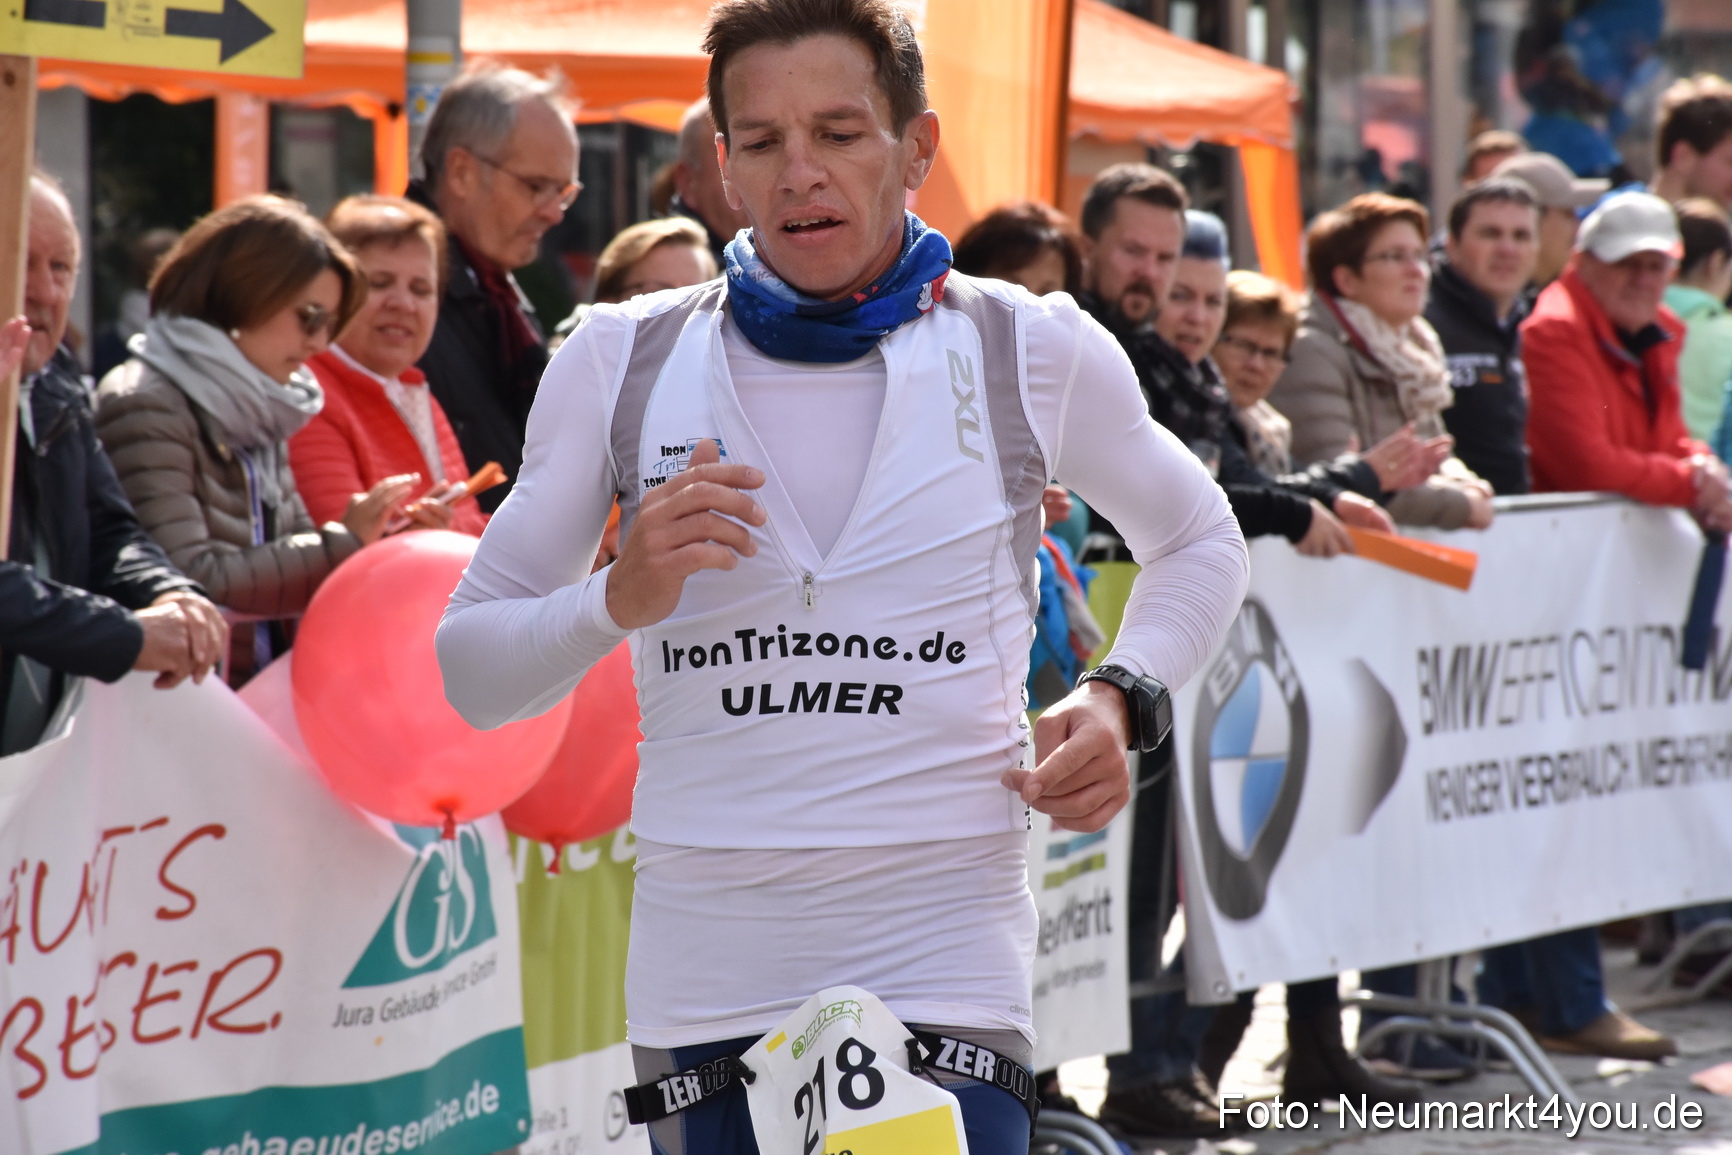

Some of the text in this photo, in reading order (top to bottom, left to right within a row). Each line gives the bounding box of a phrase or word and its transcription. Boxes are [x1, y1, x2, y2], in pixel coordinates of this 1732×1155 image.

[945, 348, 985, 464] 2XU
[662, 624, 967, 674] IronTrizone.de
[720, 681, 904, 717] ULMER
[332, 1002, 375, 1028] Jura
[657, 1057, 730, 1114] ZEROD
[794, 1037, 885, 1155] 218
[935, 1037, 1029, 1100] ZEROD
